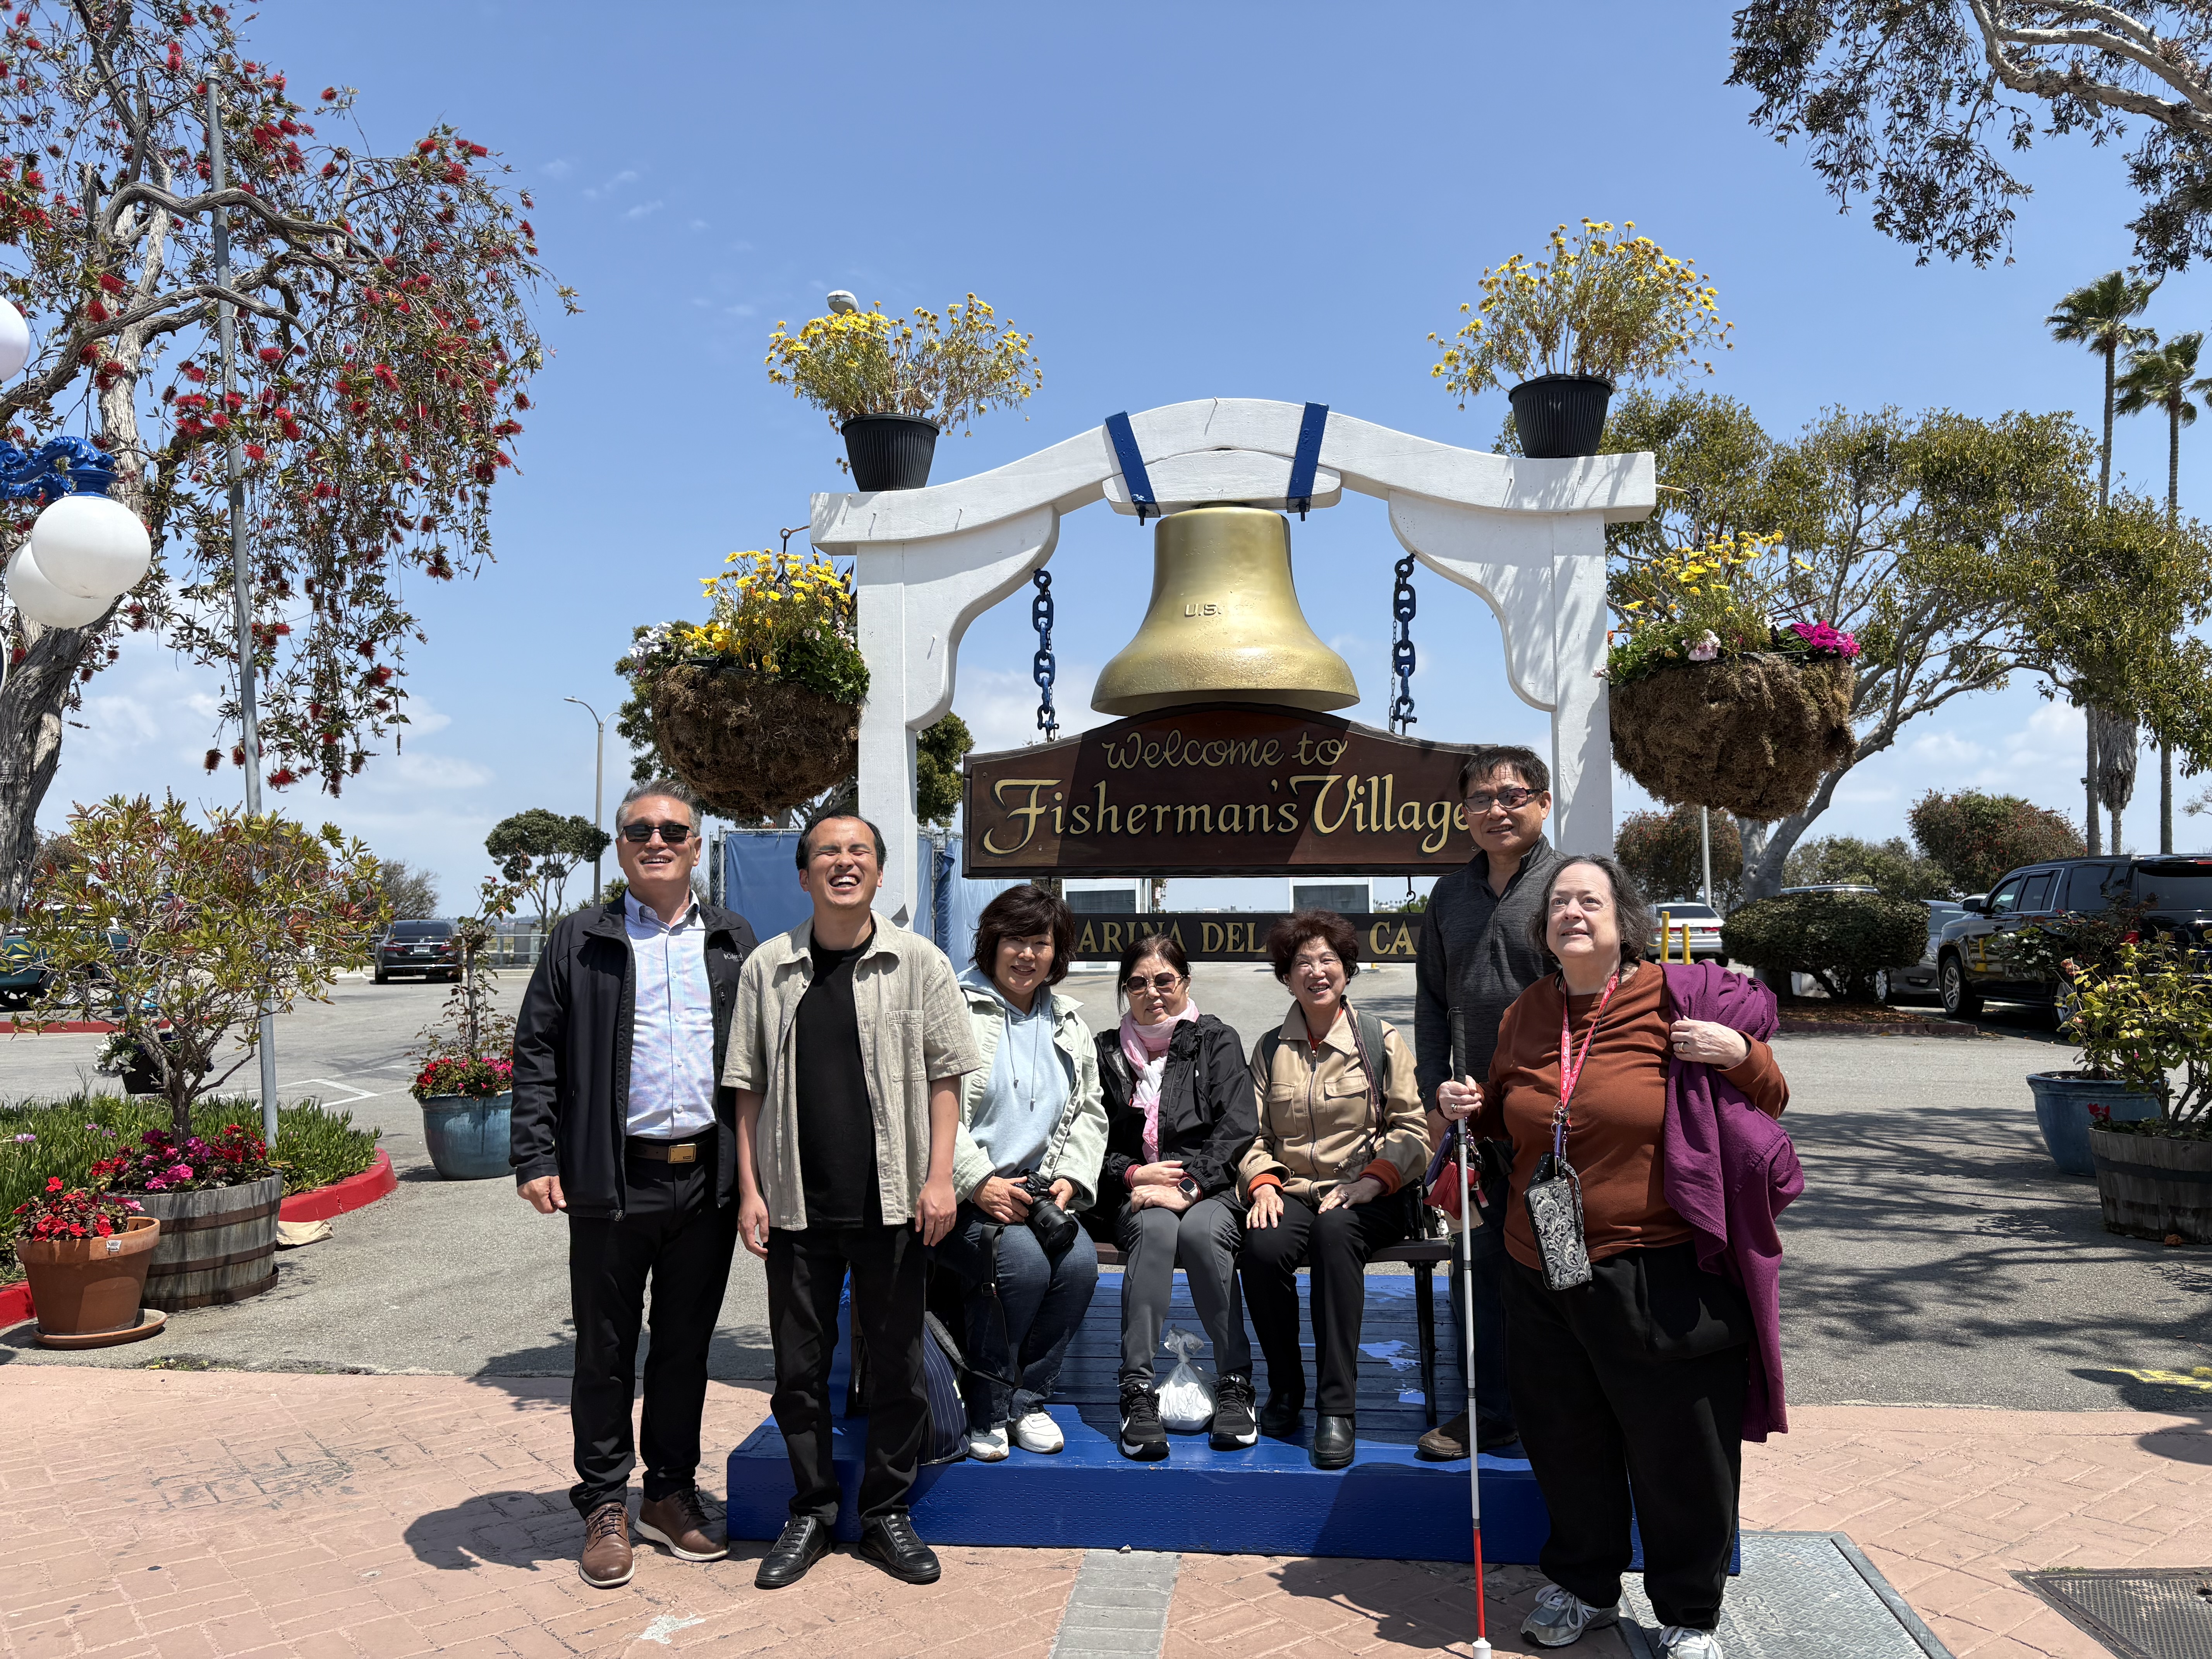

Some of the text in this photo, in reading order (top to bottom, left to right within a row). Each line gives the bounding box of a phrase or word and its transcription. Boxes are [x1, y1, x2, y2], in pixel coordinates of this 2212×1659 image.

[1185, 603, 1221, 617] U.S.
[1102, 729, 1348, 769] Welcome to
[983, 773, 1470, 854] Fisherman's Village
[1075, 917, 1417, 955] ARIA DEL CA
